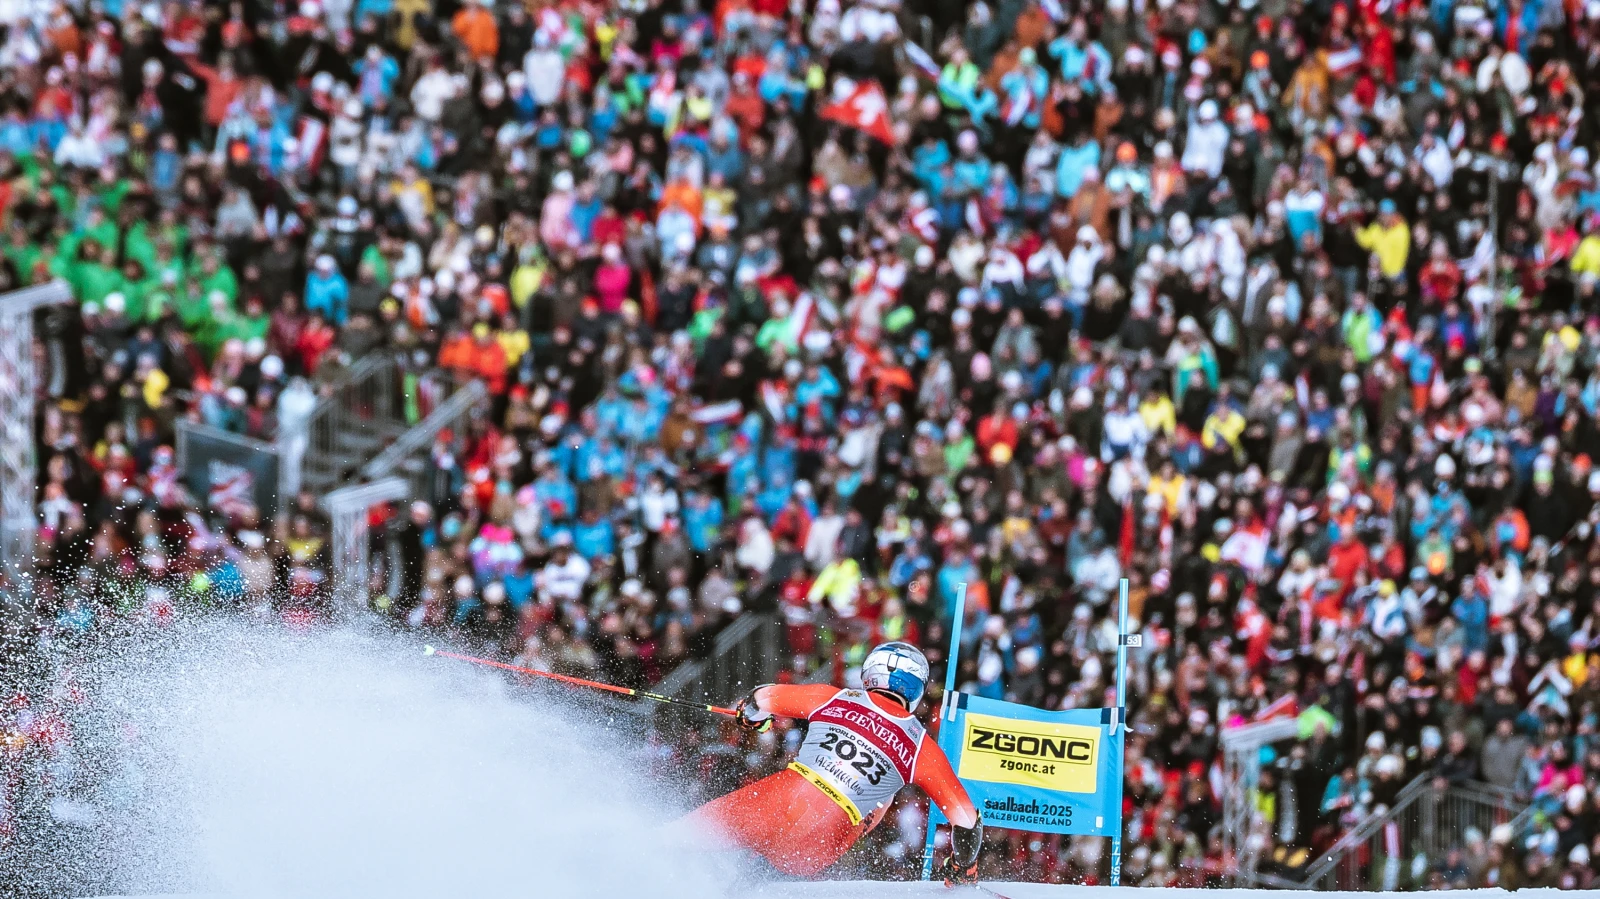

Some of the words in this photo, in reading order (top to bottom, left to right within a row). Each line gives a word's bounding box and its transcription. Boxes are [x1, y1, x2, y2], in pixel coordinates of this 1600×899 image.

[1127, 635, 1138, 645] 53
[828, 726, 856, 741] WORLD
[856, 739, 892, 771] CHAMPION
[844, 710, 914, 768] GENERALI
[971, 728, 1090, 761] ZGONC
[819, 732, 887, 786] 2023
[1000, 759, 1055, 775] zgonc.at
[814, 779, 842, 802] ZGONC
[984, 796, 1039, 814] saalbach
[1041, 804, 1072, 817] 2025
[983, 811, 1072, 827] SALZBURGERLAND
